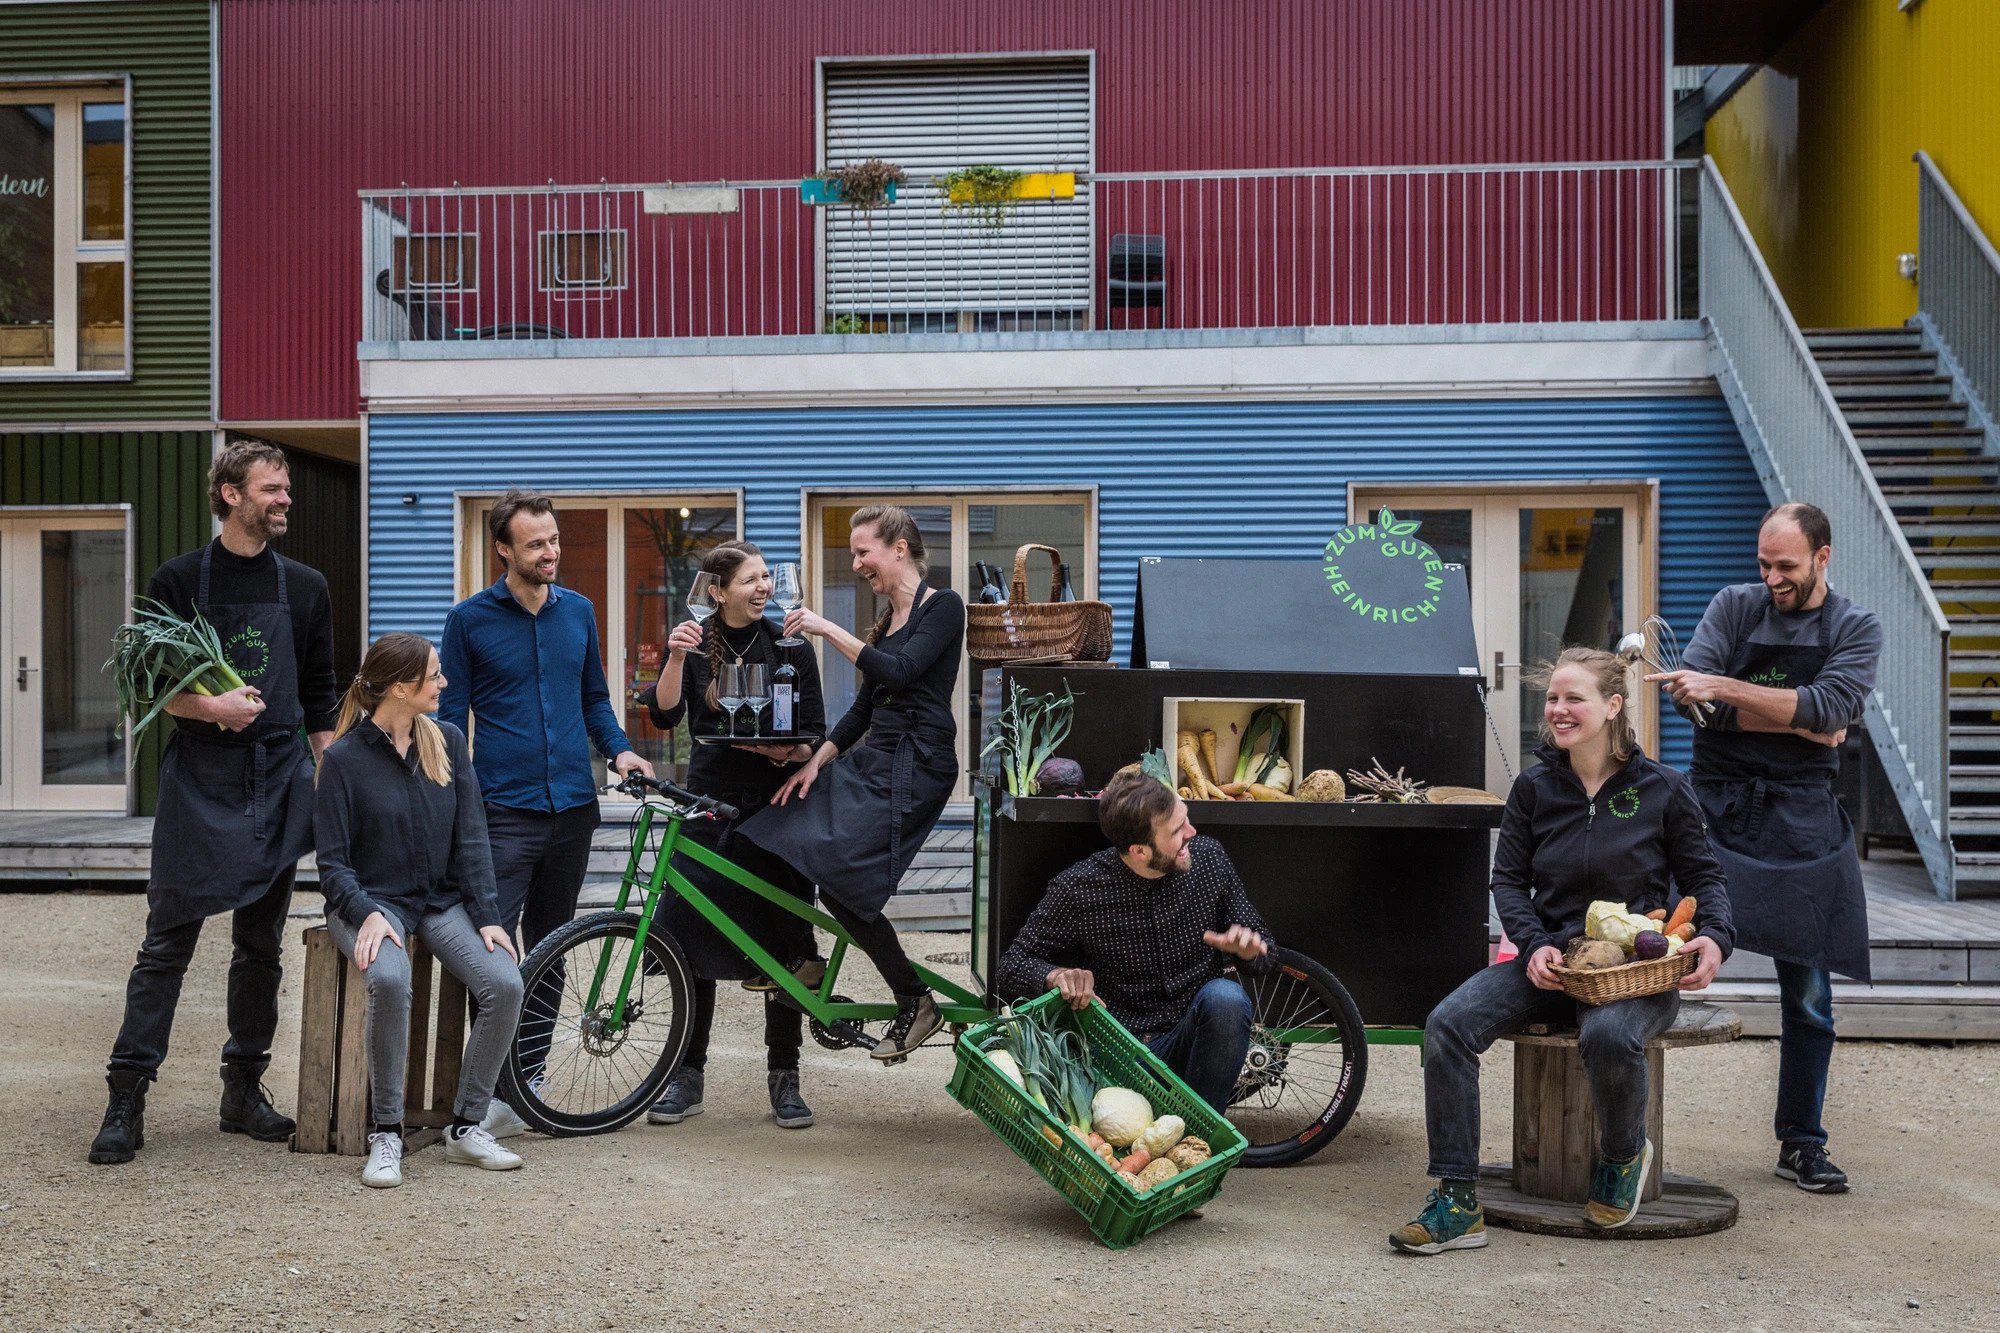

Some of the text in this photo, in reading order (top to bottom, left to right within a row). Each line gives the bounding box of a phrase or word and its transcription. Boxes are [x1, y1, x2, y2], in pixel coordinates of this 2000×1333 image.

[1325, 525, 1444, 592] ZUM GUTEN
[1322, 565, 1438, 624] HEINRICH
[225, 633, 270, 663] ZUM GUTEN
[1322, 1094, 1343, 1123] DOUBLE
